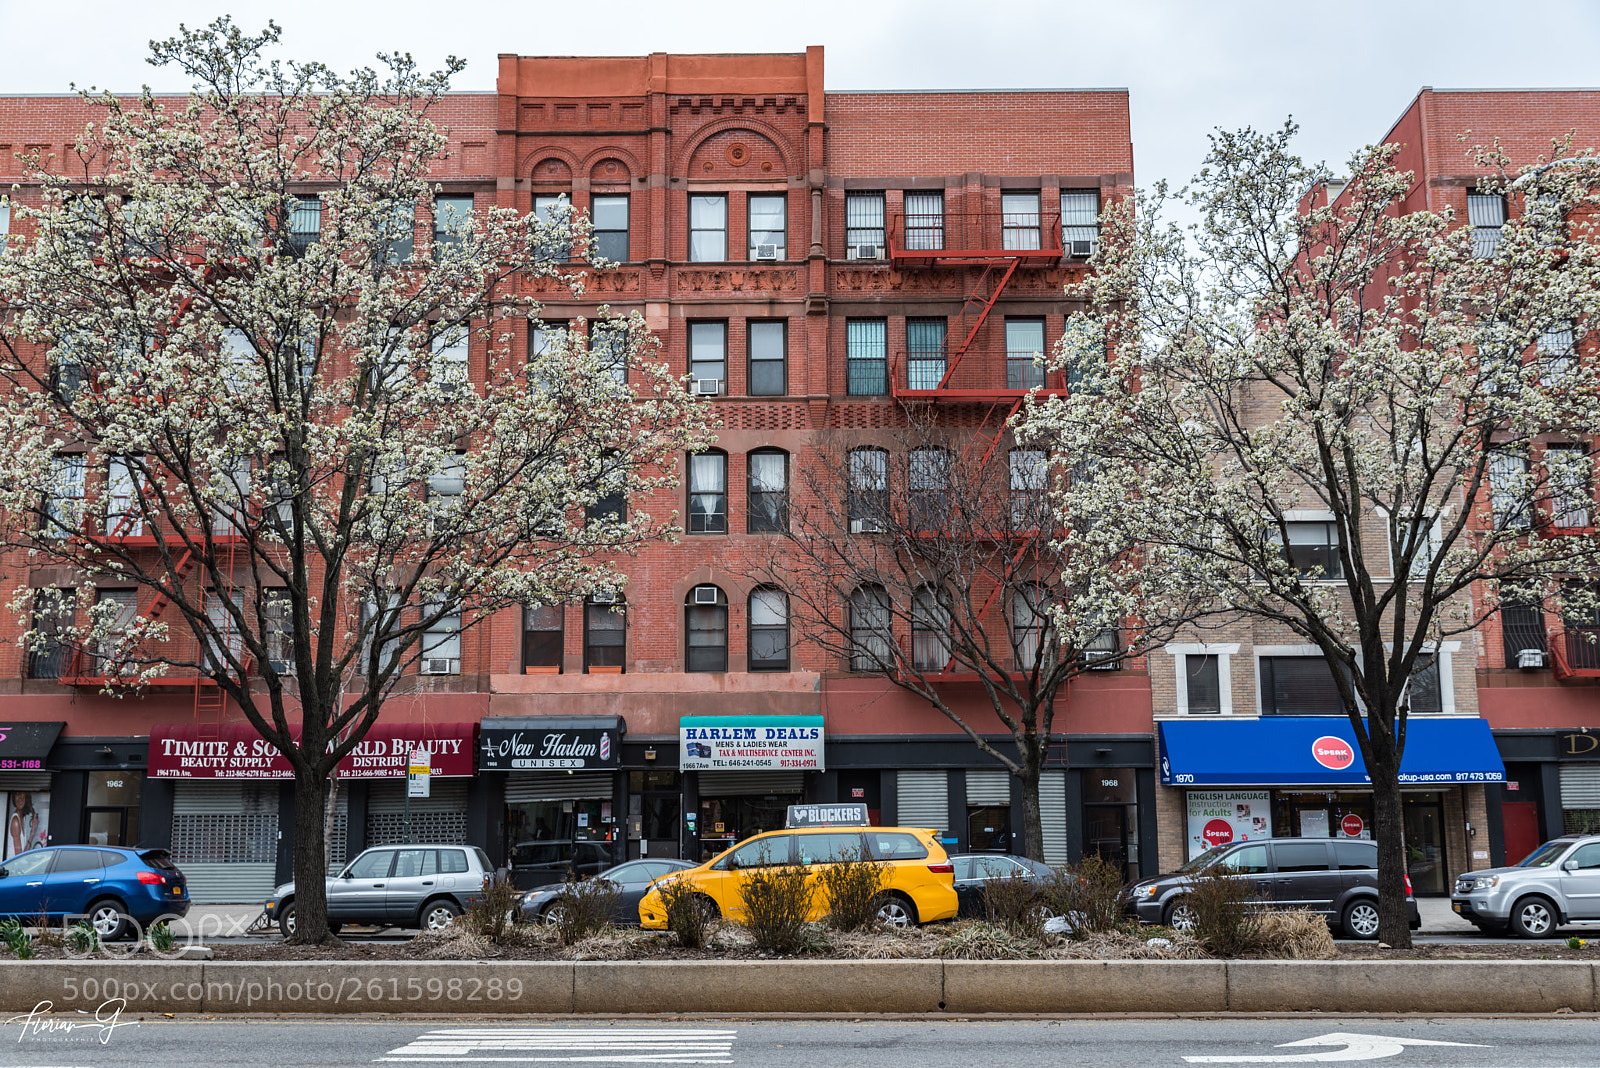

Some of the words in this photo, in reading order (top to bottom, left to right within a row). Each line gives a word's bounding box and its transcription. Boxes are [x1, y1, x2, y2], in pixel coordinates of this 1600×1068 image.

[686, 728, 756, 740] HARLEM
[765, 728, 819, 740] DEALS
[161, 738, 229, 757] TIMITE
[233, 741, 248, 757] &
[391, 738, 463, 756] BEAUTY
[498, 732, 534, 757] New
[540, 733, 597, 757] Harlem
[719, 749, 730, 757] TAX
[731, 749, 736, 757] &
[737, 749, 778, 757] MULTISERVICE
[780, 749, 804, 757] CENTER
[804, 749, 817, 757] INC.
[181, 757, 228, 768] BEAUTY
[230, 757, 274, 768] SUPPLY
[352, 756, 407, 767] DISTRIBU
[712, 759, 727, 767] TEL:
[728, 759, 772, 767] 646-241-0545
[215, 769, 225, 777] Tel:
[339, 769, 351, 777] Tel:
[393, 768, 406, 776] Fax:
[1456, 772, 1469, 781] 917
[1469, 772, 1484, 781] 473
[106, 780, 123, 788] 1962
[1101, 779, 1119, 787] 1968
[1188, 792, 1224, 800] ENGLISH
[1225, 792, 1269, 800] LANGUAGE
[1188, 800, 1232, 808] Instruction
[808, 807, 862, 823] BLOCKERS
[1188, 808, 1201, 817] for
[1203, 808, 1232, 817] Adults
